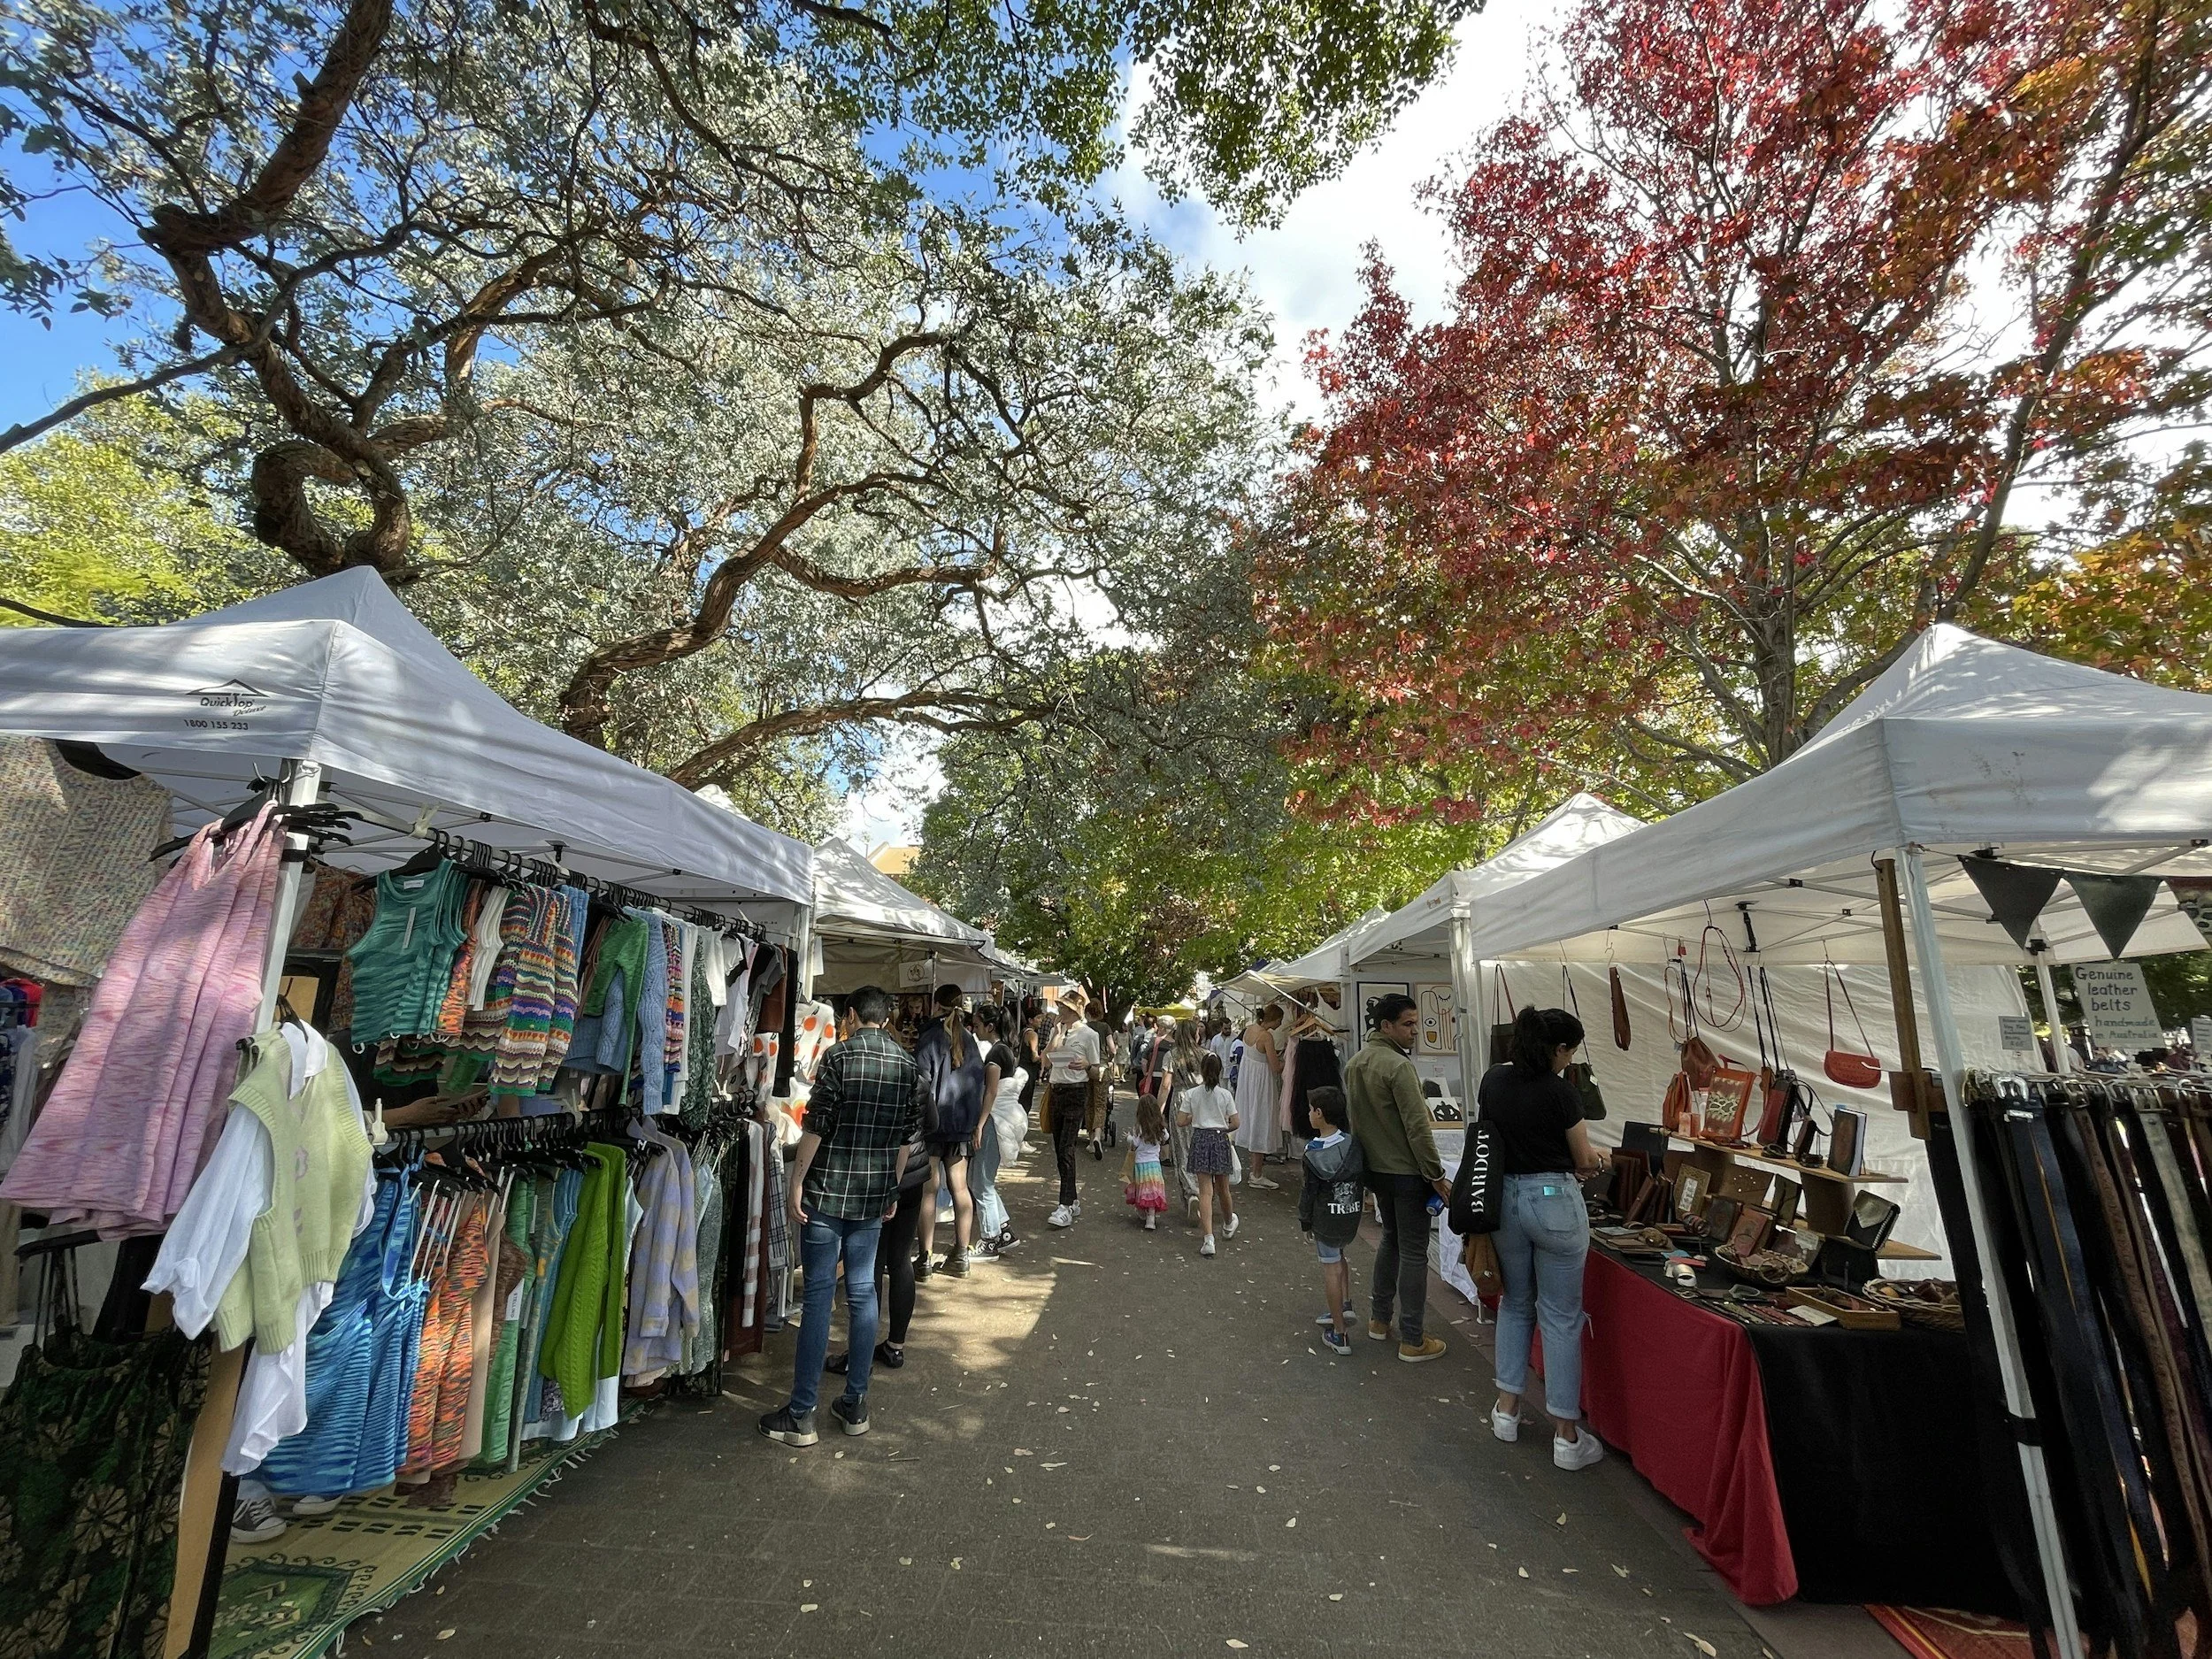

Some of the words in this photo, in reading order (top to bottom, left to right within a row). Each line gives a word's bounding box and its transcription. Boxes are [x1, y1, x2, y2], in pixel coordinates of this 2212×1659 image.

[183, 718, 208, 728] 1800
[211, 720, 228, 729] 155
[2075, 966, 2134, 980] Genuine
[2087, 982, 2138, 995] leather
[2092, 997, 2131, 1011] belts
[2094, 1016, 2155, 1026] handmade
[2109, 1030, 2157, 1039] Australia
[1471, 1130, 1490, 1213] BARDOT
